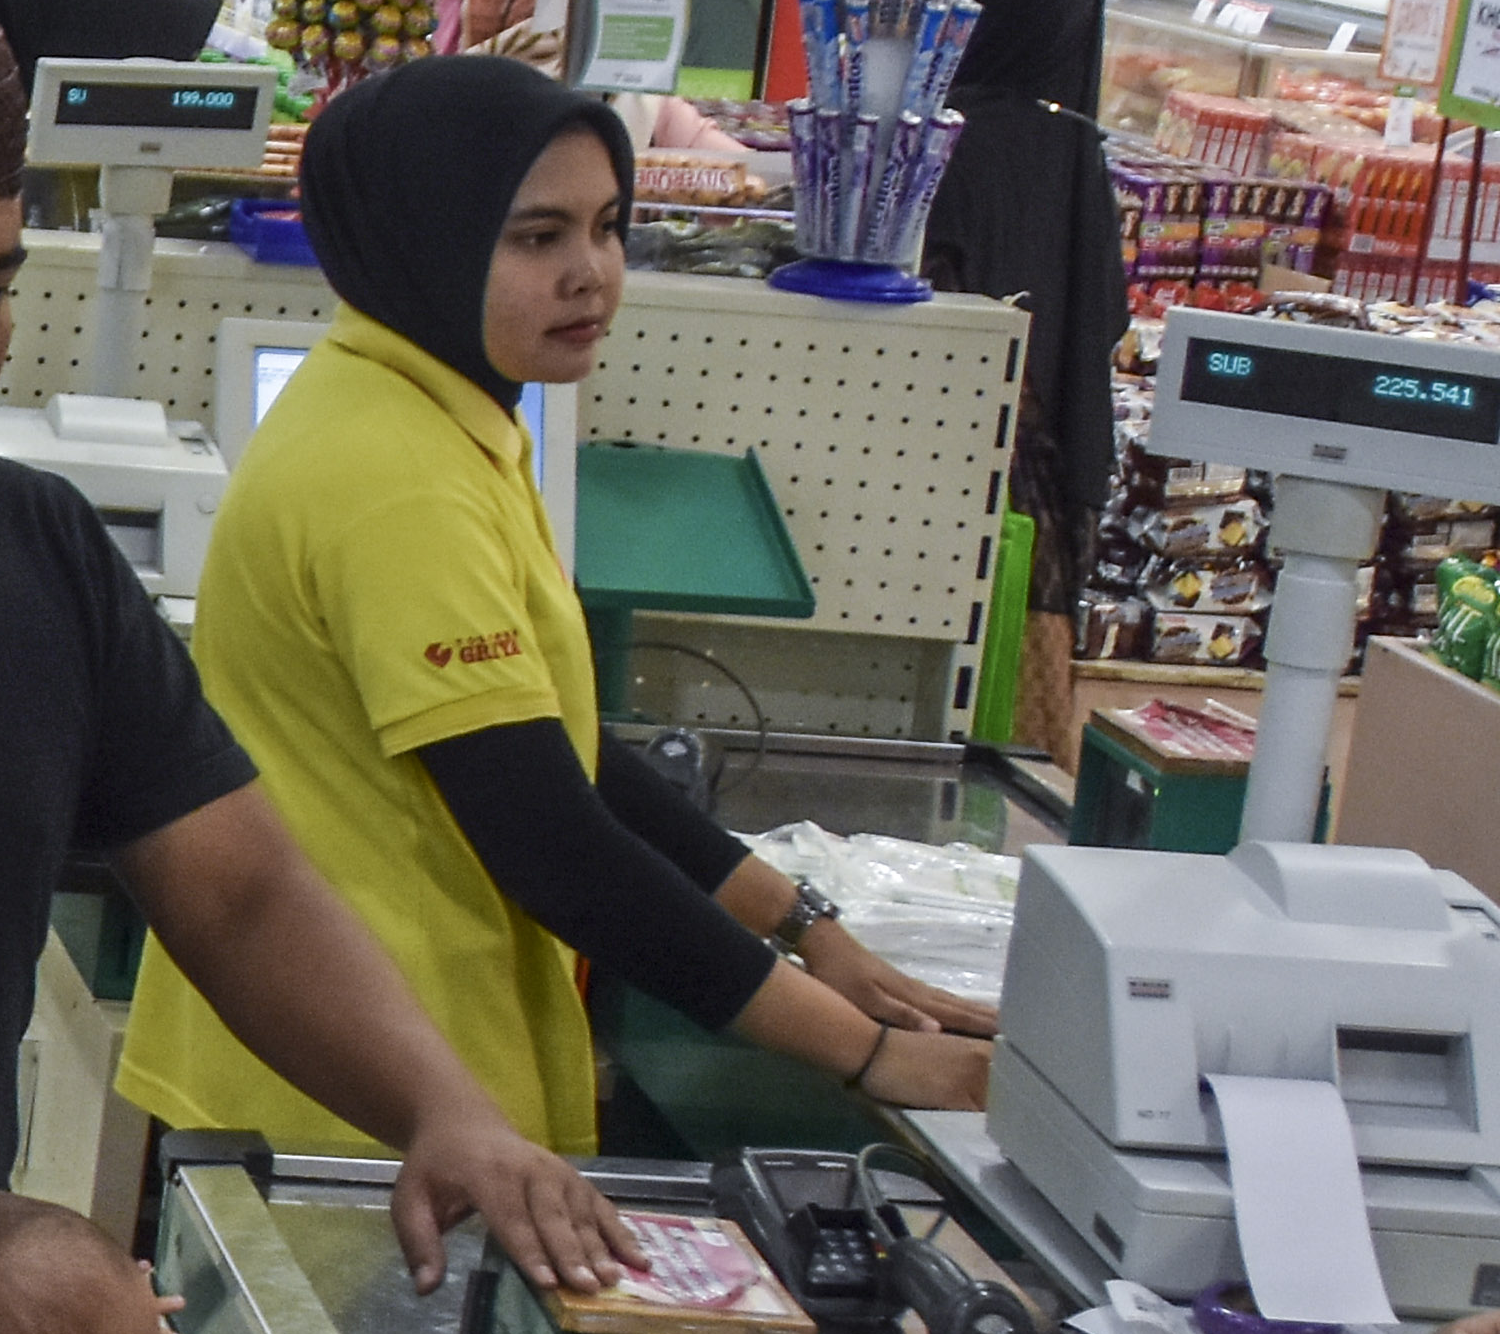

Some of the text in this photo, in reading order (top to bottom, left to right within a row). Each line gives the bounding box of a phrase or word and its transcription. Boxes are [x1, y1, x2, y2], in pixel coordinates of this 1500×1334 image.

[171, 89, 234, 107] 199.000
[1207, 352, 1474, 408] SUB 225.541
